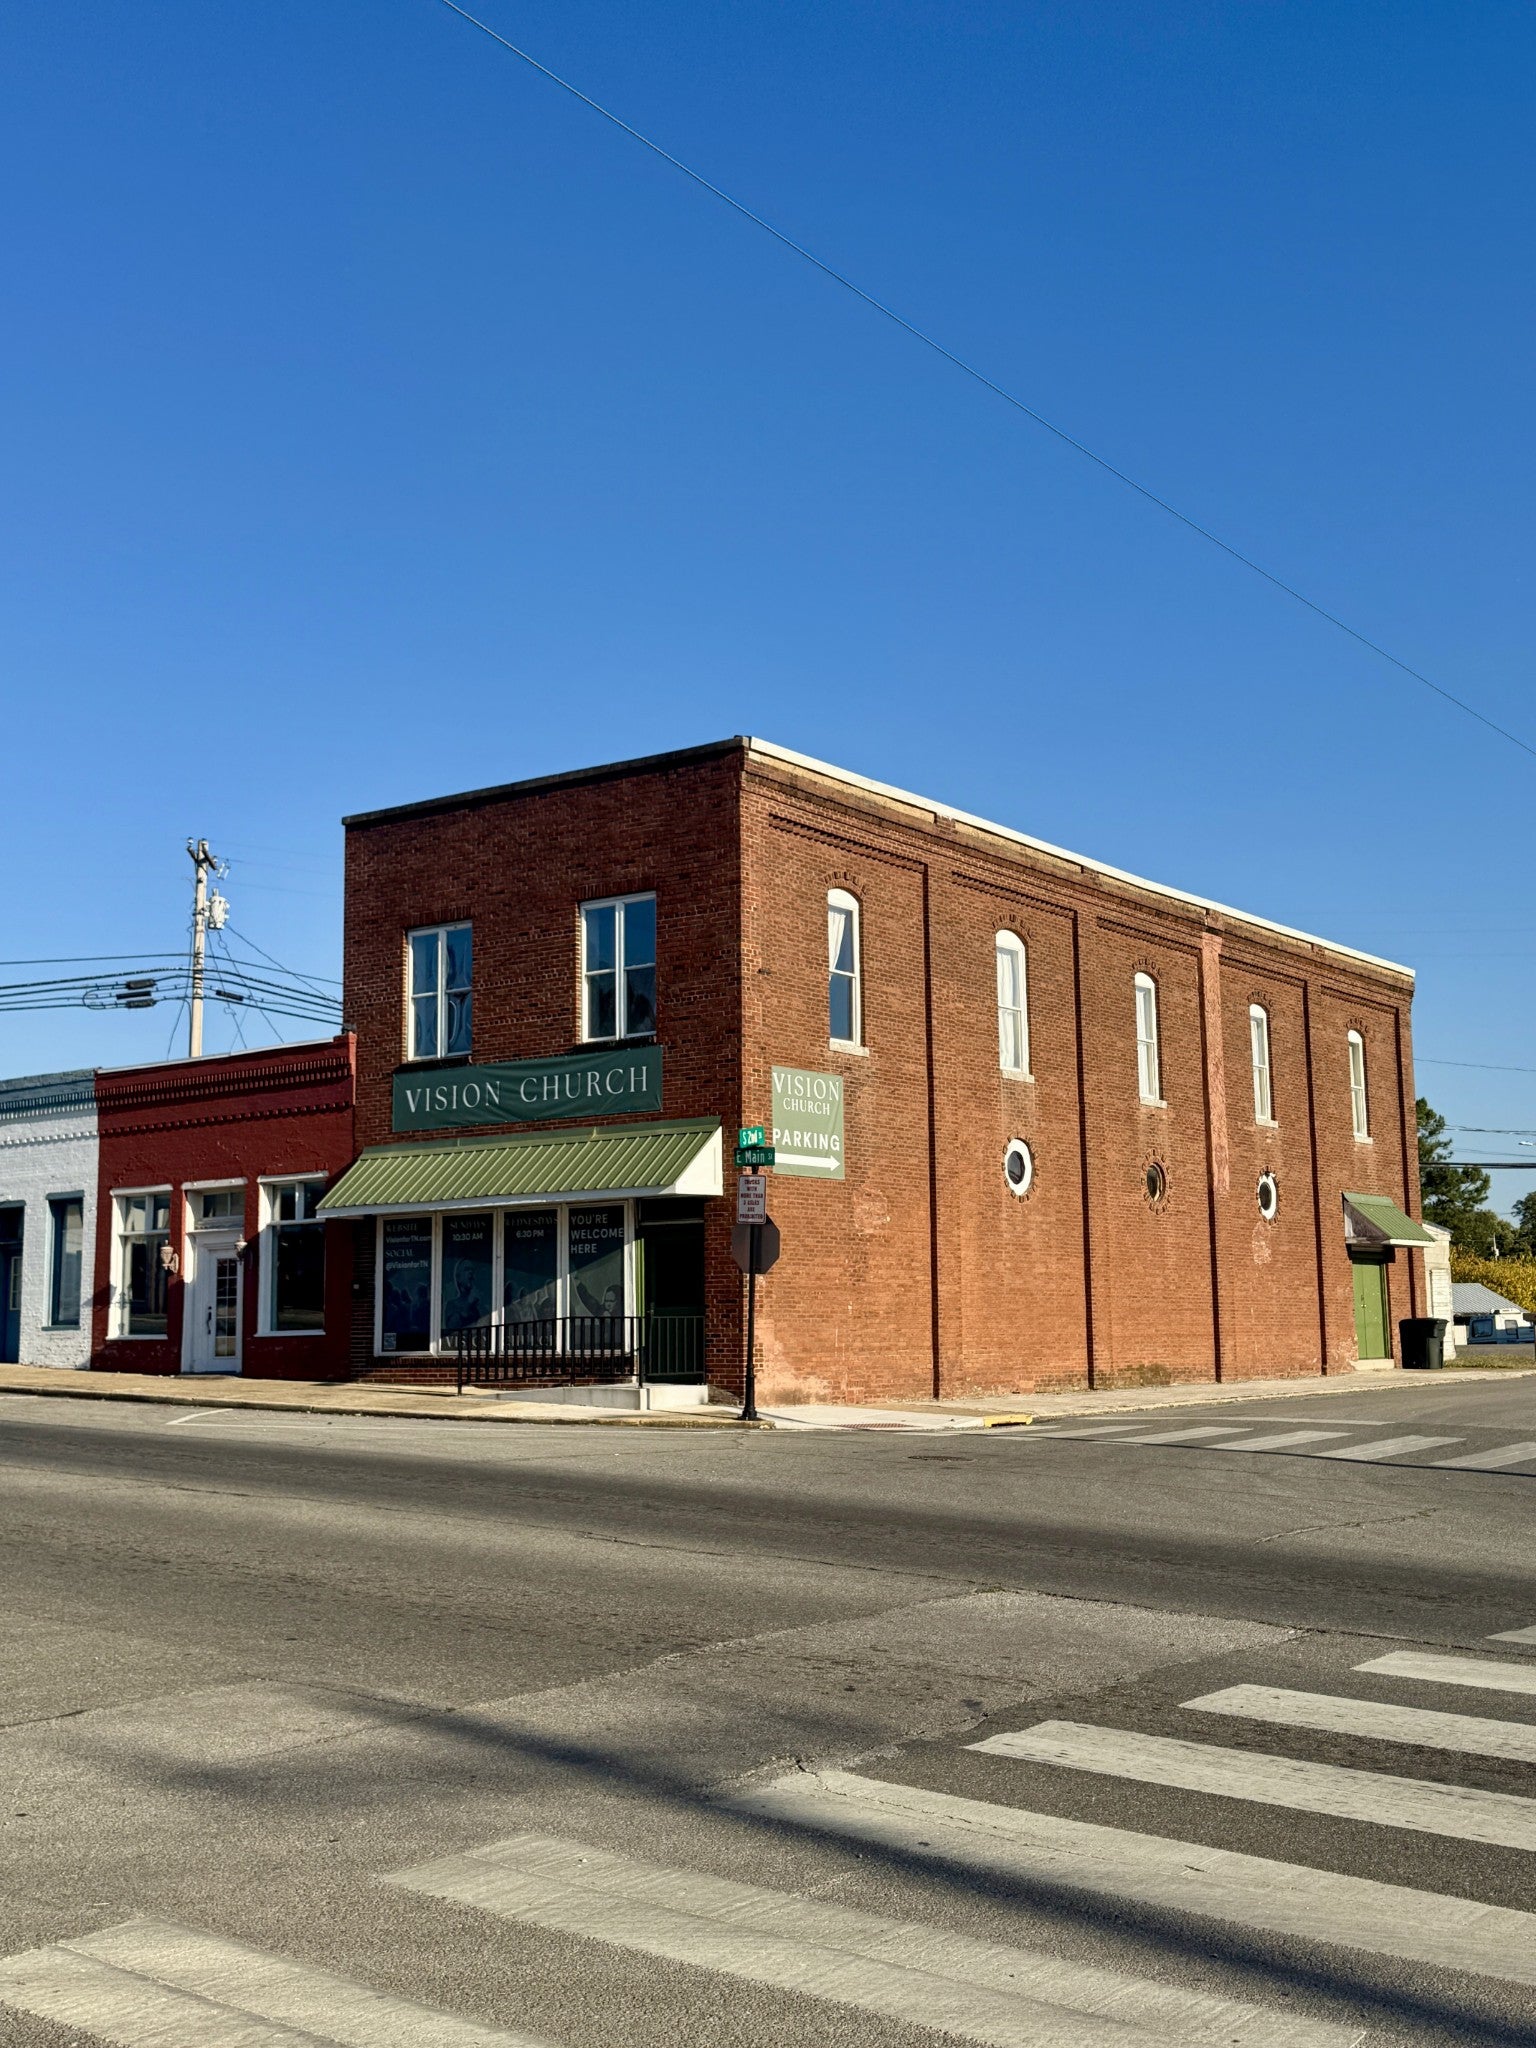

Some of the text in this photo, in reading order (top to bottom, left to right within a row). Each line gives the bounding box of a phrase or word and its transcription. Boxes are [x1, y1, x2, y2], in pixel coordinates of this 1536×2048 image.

[405, 1065, 648, 1113] VISION CHURCH
[772, 1072, 840, 1101] VISION
[783, 1097, 830, 1115] CHURCH
[742, 1131, 747, 1145] S
[773, 1128, 840, 1151] PARKING
[736, 1150, 742, 1163] E
[745, 1149, 765, 1164] Main
[570, 1213, 608, 1225] YOU'RE
[452, 1232, 483, 1241] 10:30 AM
[515, 1229, 544, 1238] 6:30 PM
[570, 1227, 624, 1240] WELCOME
[385, 1248, 415, 1257] SOCIAL
[570, 1243, 597, 1254] HERE
